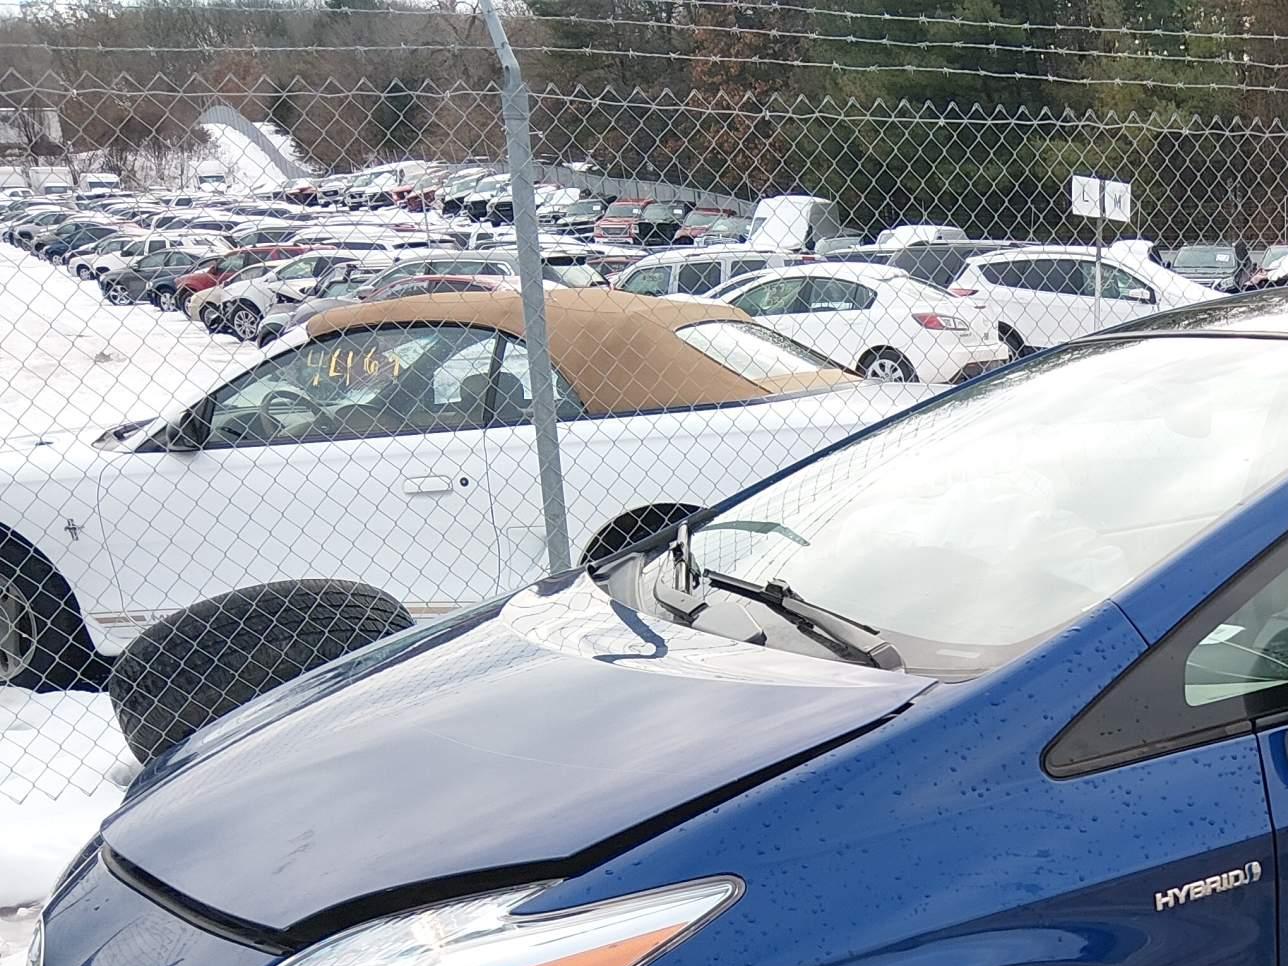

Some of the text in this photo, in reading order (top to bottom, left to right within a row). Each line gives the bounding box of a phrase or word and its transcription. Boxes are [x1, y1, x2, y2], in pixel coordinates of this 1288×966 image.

[1082, 184, 1089, 202] L
[1113, 193, 1122, 209] M
[1154, 868, 1245, 912] HYBRID
